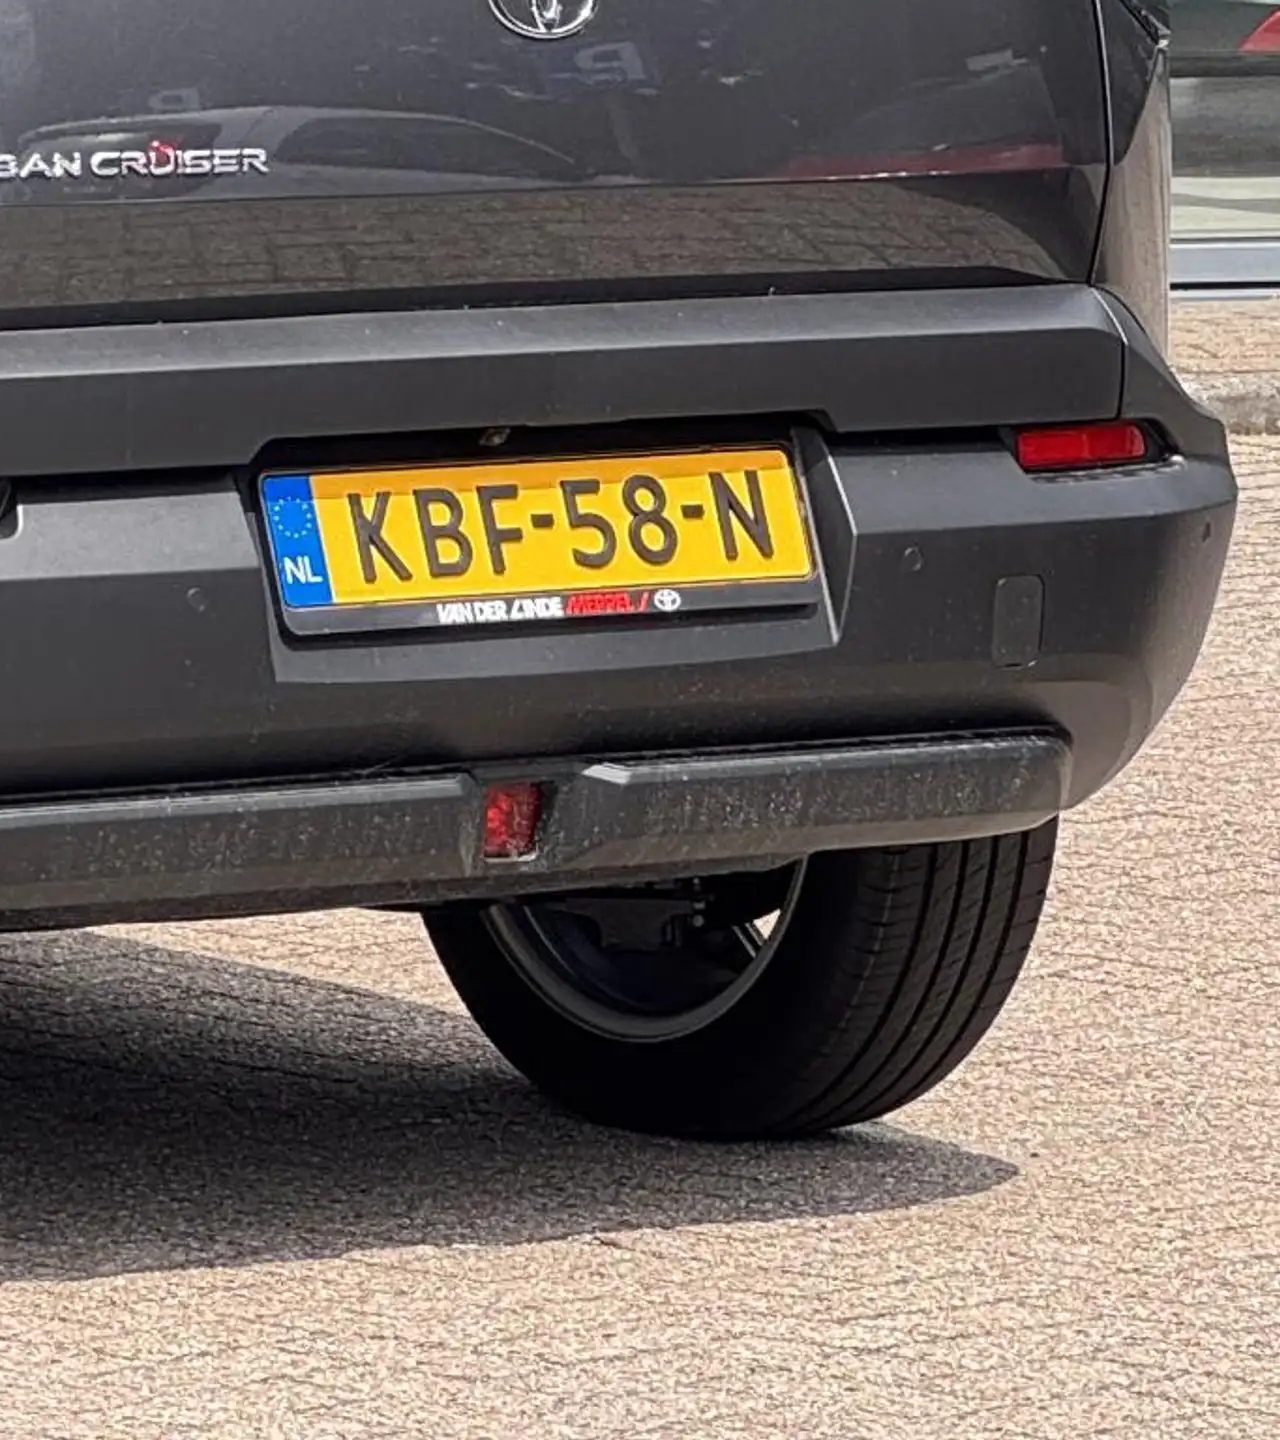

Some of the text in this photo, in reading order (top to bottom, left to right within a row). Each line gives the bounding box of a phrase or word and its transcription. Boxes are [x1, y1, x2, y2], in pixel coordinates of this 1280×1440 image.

[90, 147, 270, 178] CRUISER
[347, 469, 773, 584] KBF-58-N
[284, 557, 324, 584] NL
